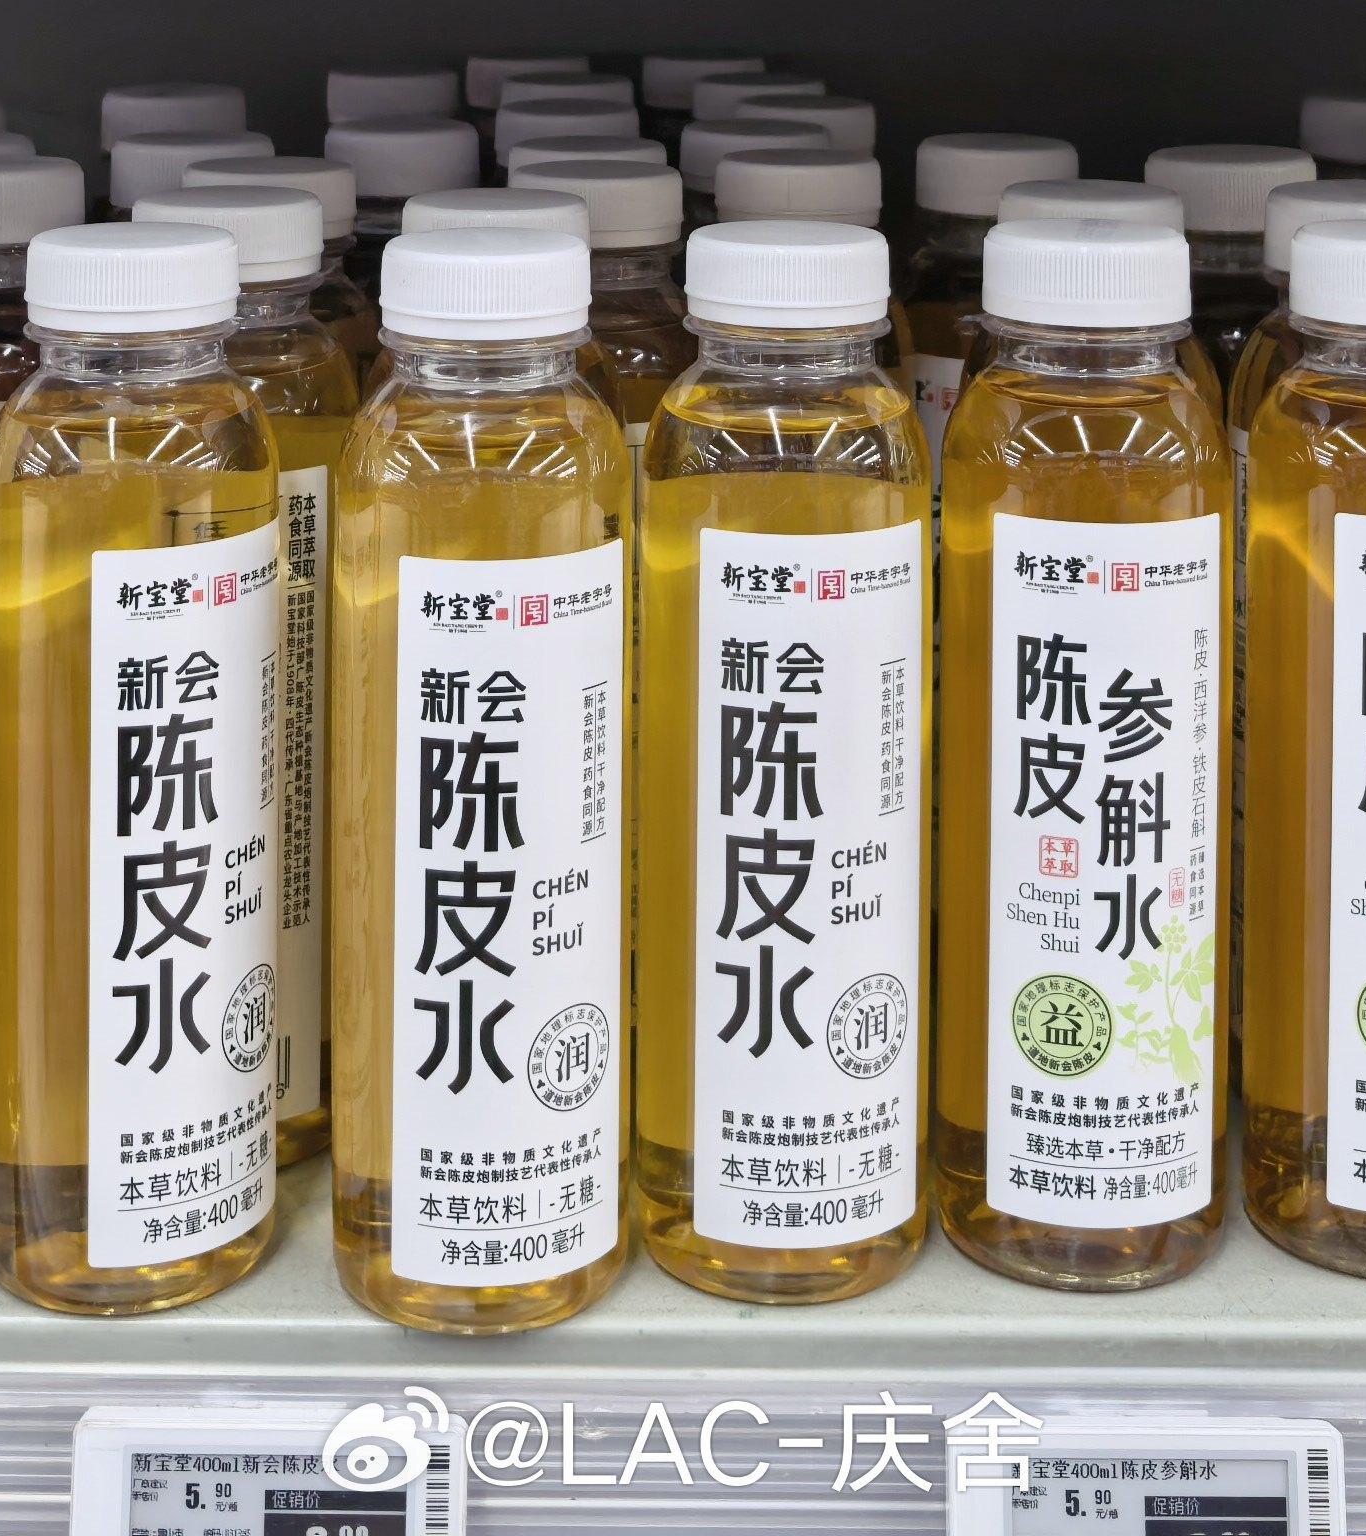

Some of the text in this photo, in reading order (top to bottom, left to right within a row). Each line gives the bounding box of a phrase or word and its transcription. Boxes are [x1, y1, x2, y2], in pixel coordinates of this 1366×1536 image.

[117, 577, 192, 610] 新宝堂
[720, 561, 911, 594] 新宝堂 中华老字号
[117, 651, 219, 711] 新会
[420, 667, 526, 724] 新会
[112, 713, 219, 1074] 陈皮水
[715, 701, 824, 1059] 陈皮水
[413, 731, 525, 1095] 陈皮水
[1006, 902, 1080, 931] Shen Hu
[243, 994, 266, 1045] 润
[1040, 1003, 1084, 1046] 益
[1009, 1164, 1096, 1200] 本草饮料
[419, 1192, 526, 1225] 本草饮料
[272, 1491, 320, 1508] 促销价
[1154, 1498, 1200, 1515] 促销价
